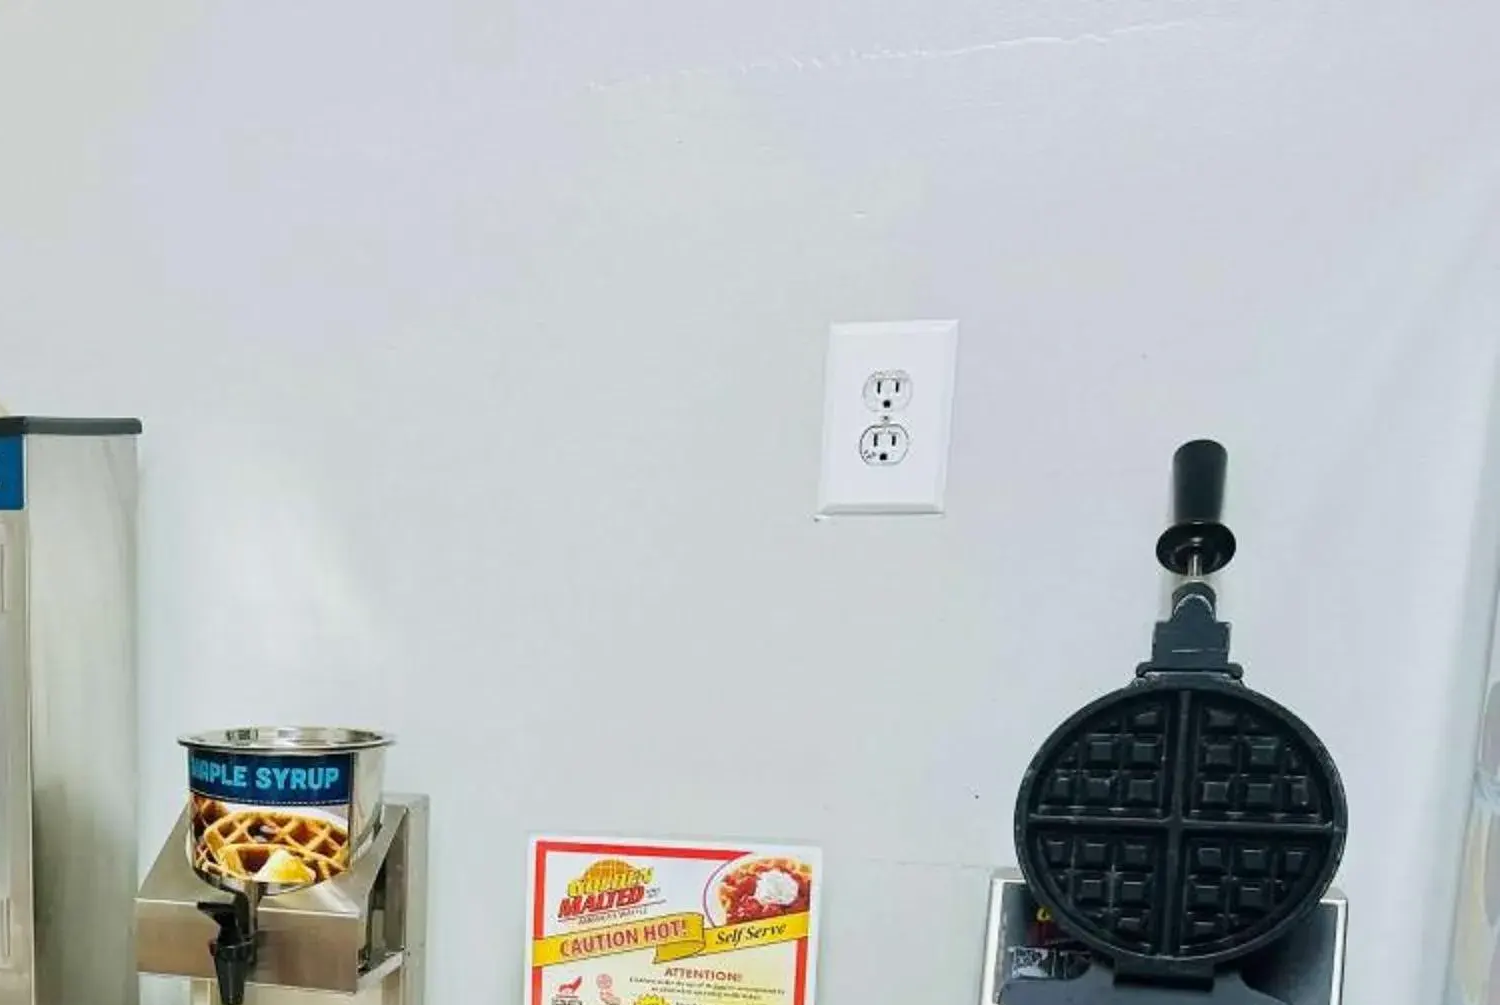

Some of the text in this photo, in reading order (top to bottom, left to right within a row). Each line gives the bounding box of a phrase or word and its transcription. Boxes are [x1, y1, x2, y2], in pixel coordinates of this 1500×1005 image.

[255, 767, 340, 790] SYRUP
[560, 920, 687, 957] CAUTION HOT!
[716, 923, 787, 947] Self Serve
[664, 967, 743, 982] ATTENTION!
